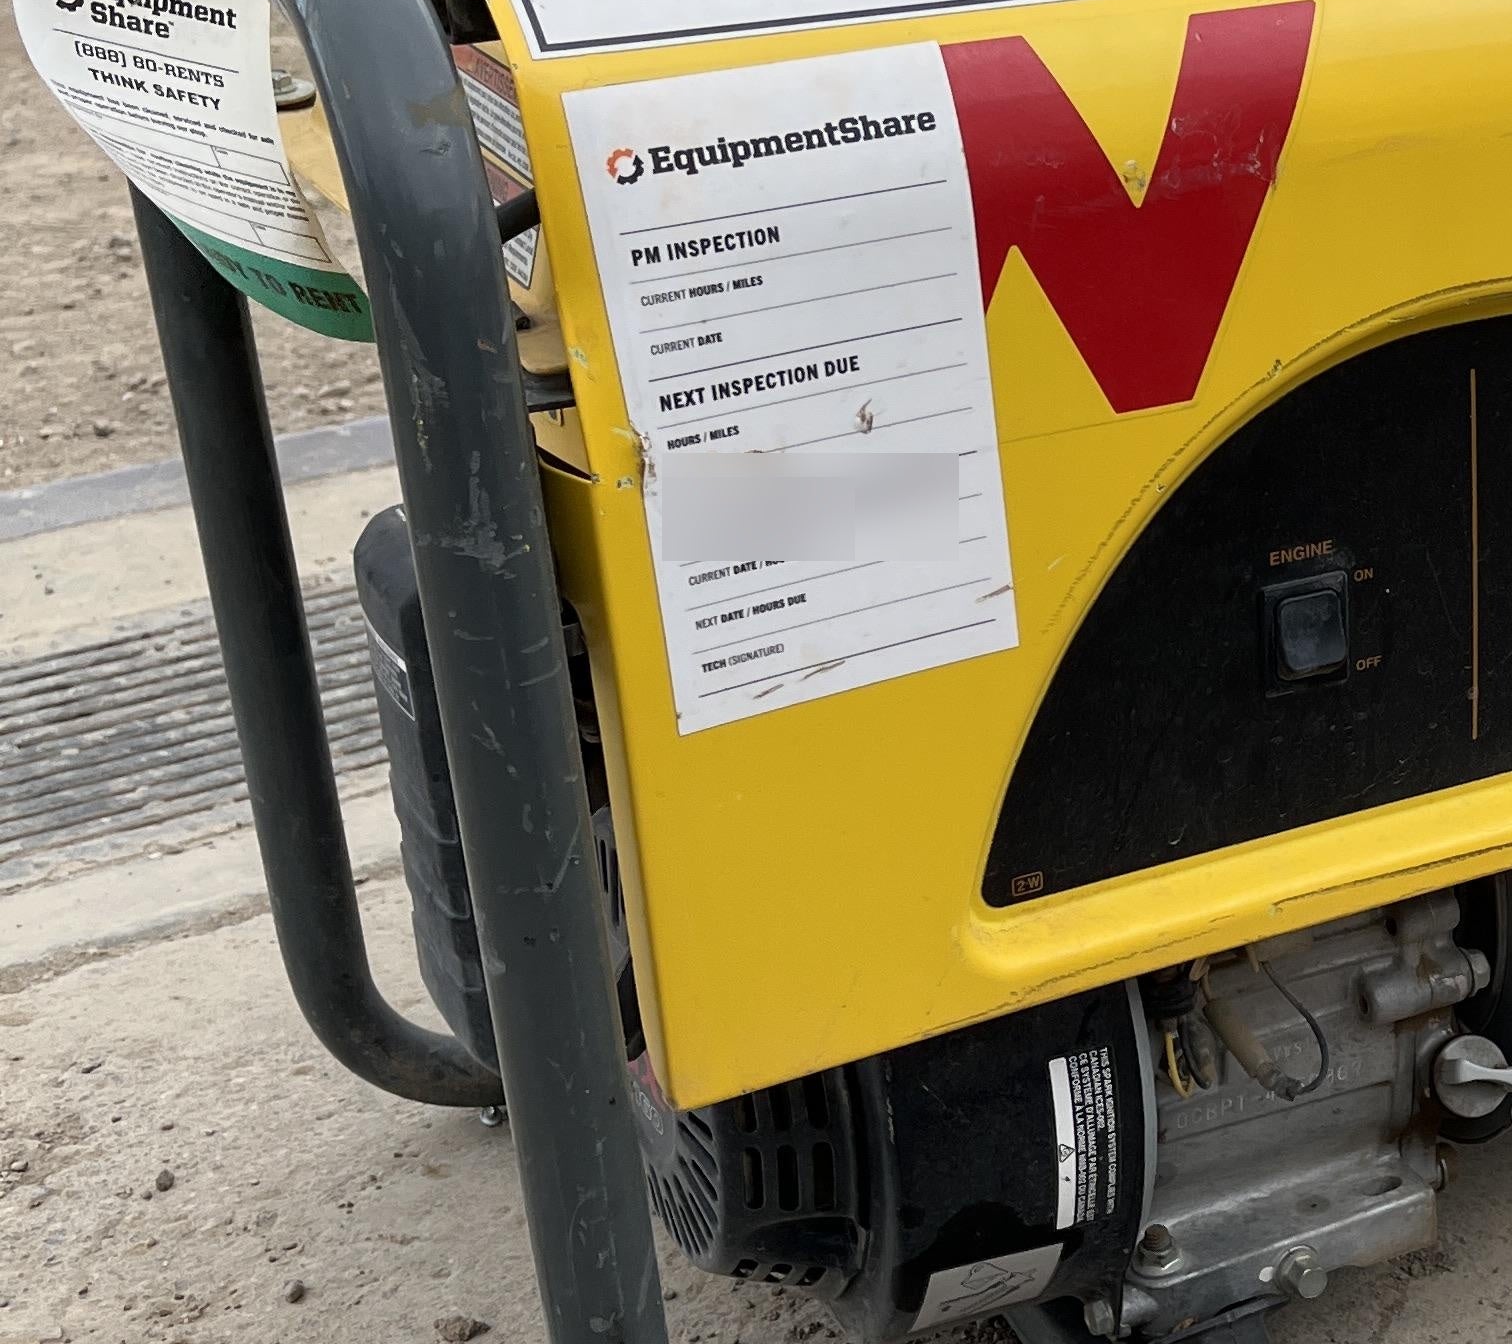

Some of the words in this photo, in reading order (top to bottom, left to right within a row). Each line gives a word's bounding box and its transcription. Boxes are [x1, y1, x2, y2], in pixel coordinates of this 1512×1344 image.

[75, 40, 127, 68] (888)
[133, 55, 225, 88] 80-RENTS
[88, 67, 149, 93] THINK
[153, 83, 221, 111] SAFETY
[648, 111, 936, 176] EquipmentShare
[631, 246, 661, 267] PM
[666, 226, 780, 261] INSPECTION
[287, 280, 363, 314] RENT
[640, 289, 687, 307] CURRENT
[689, 282, 725, 299] HOURS
[732, 275, 764, 290] MILES
[650, 337, 695, 356] CURRENT
[697, 332, 723, 347] DATE
[659, 388, 706, 412] NEXT
[711, 363, 819, 401] INSPECTION
[824, 355, 860, 377] DUE
[667, 433, 702, 450] HOURS
[709, 425, 740, 441] MILES
[1269, 540, 1333, 566] ENGINE
[688, 566, 731, 586] CURRENT
[733, 560, 758, 575] DATE
[1354, 568, 1374, 582] ON
[695, 615, 719, 631] NEXT
[720, 609, 745, 624] DATE
[752, 599, 785, 616] HOURS
[787, 593, 807, 607] DUE
[701, 659, 727, 673] TECH
[728, 643, 785, 666] (SIGNATURE)
[1356, 655, 1383, 671] OFF
